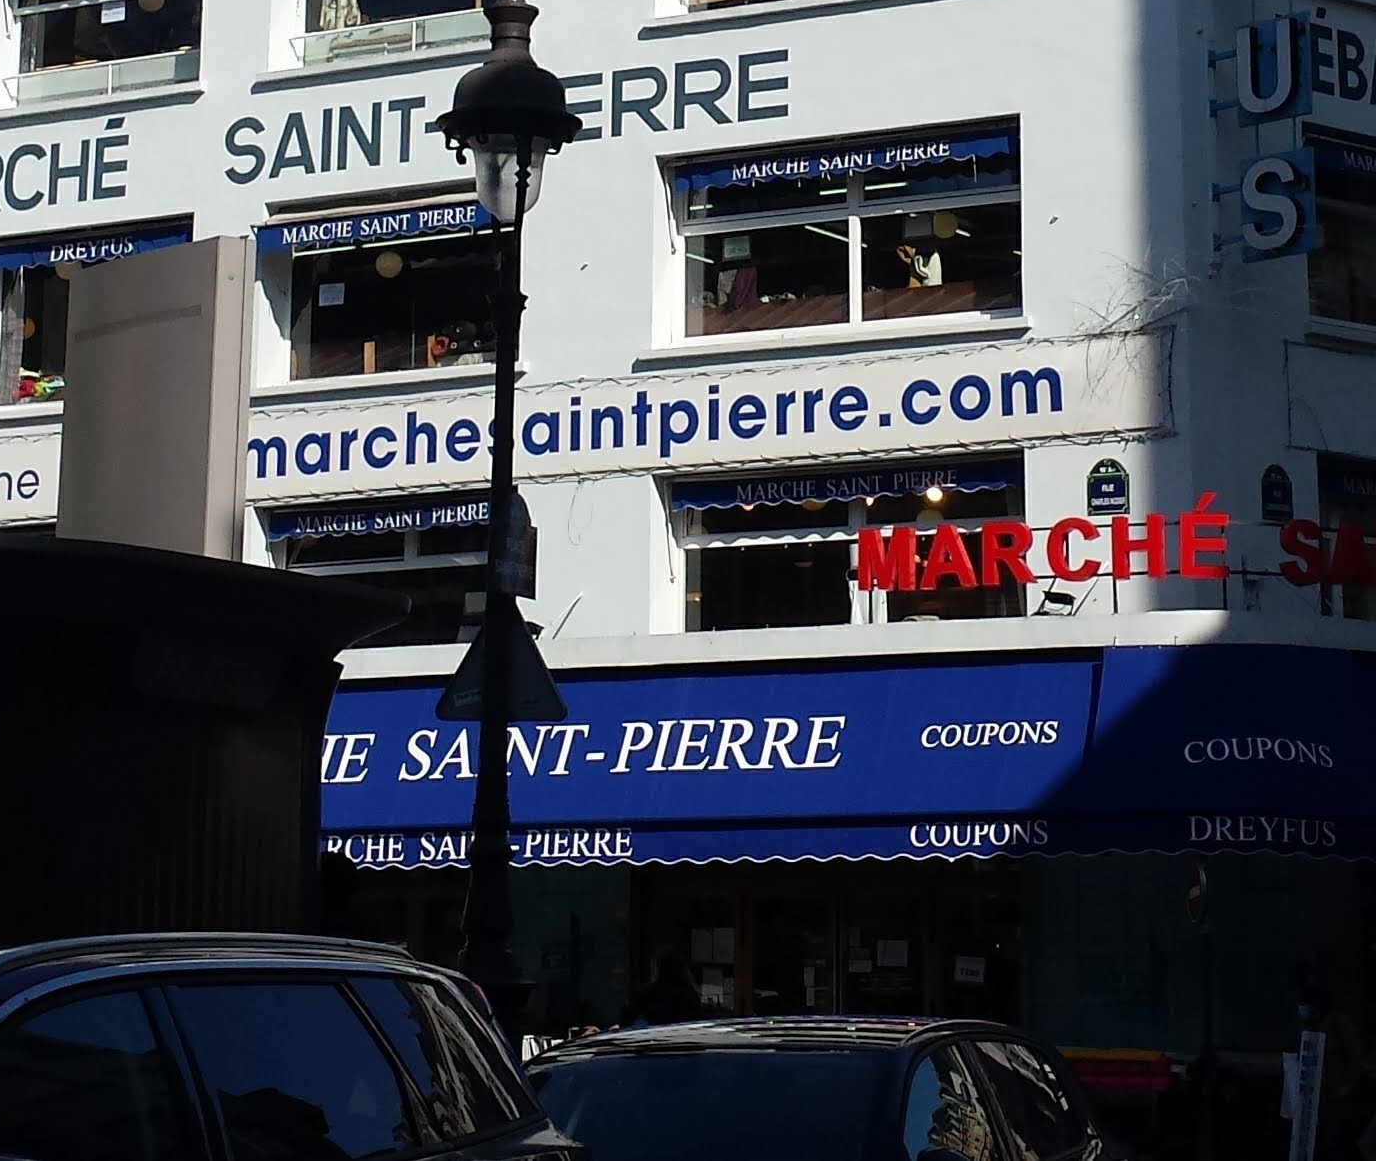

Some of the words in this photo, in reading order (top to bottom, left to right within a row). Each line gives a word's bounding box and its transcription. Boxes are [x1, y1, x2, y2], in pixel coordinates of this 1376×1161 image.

[225, 49, 789, 185] SAINT-ERRE
[731, 155, 811, 181] MARCHE
[819, 148, 874, 172] SAINT
[884, 139, 951, 163] PIERRE
[281, 218, 353, 244] MARCHE
[359, 213, 412, 236] SAINT
[417, 204, 477, 229] PIERRE
[49, 235, 134, 264] DREYFUS
[736, 479, 816, 503] MARCHE
[826, 476, 884, 496] SAINT
[893, 470, 958, 492] PIERRE
[296, 514, 367, 533] MARCHE
[375, 510, 423, 528] SAINT
[432, 502, 489, 523] PIERRE
[858, 492, 1229, 592] MARCHÉ
[398, 715, 846, 781] SANT-PIERRE
[920, 720, 1059, 749] COUPONS
[1184, 736, 1334, 768] COUPONS
[419, 828, 632, 862] SAI-PIERRE
[909, 821, 1048, 849] COUPONS
[1187, 816, 1336, 847] DREYFUS
